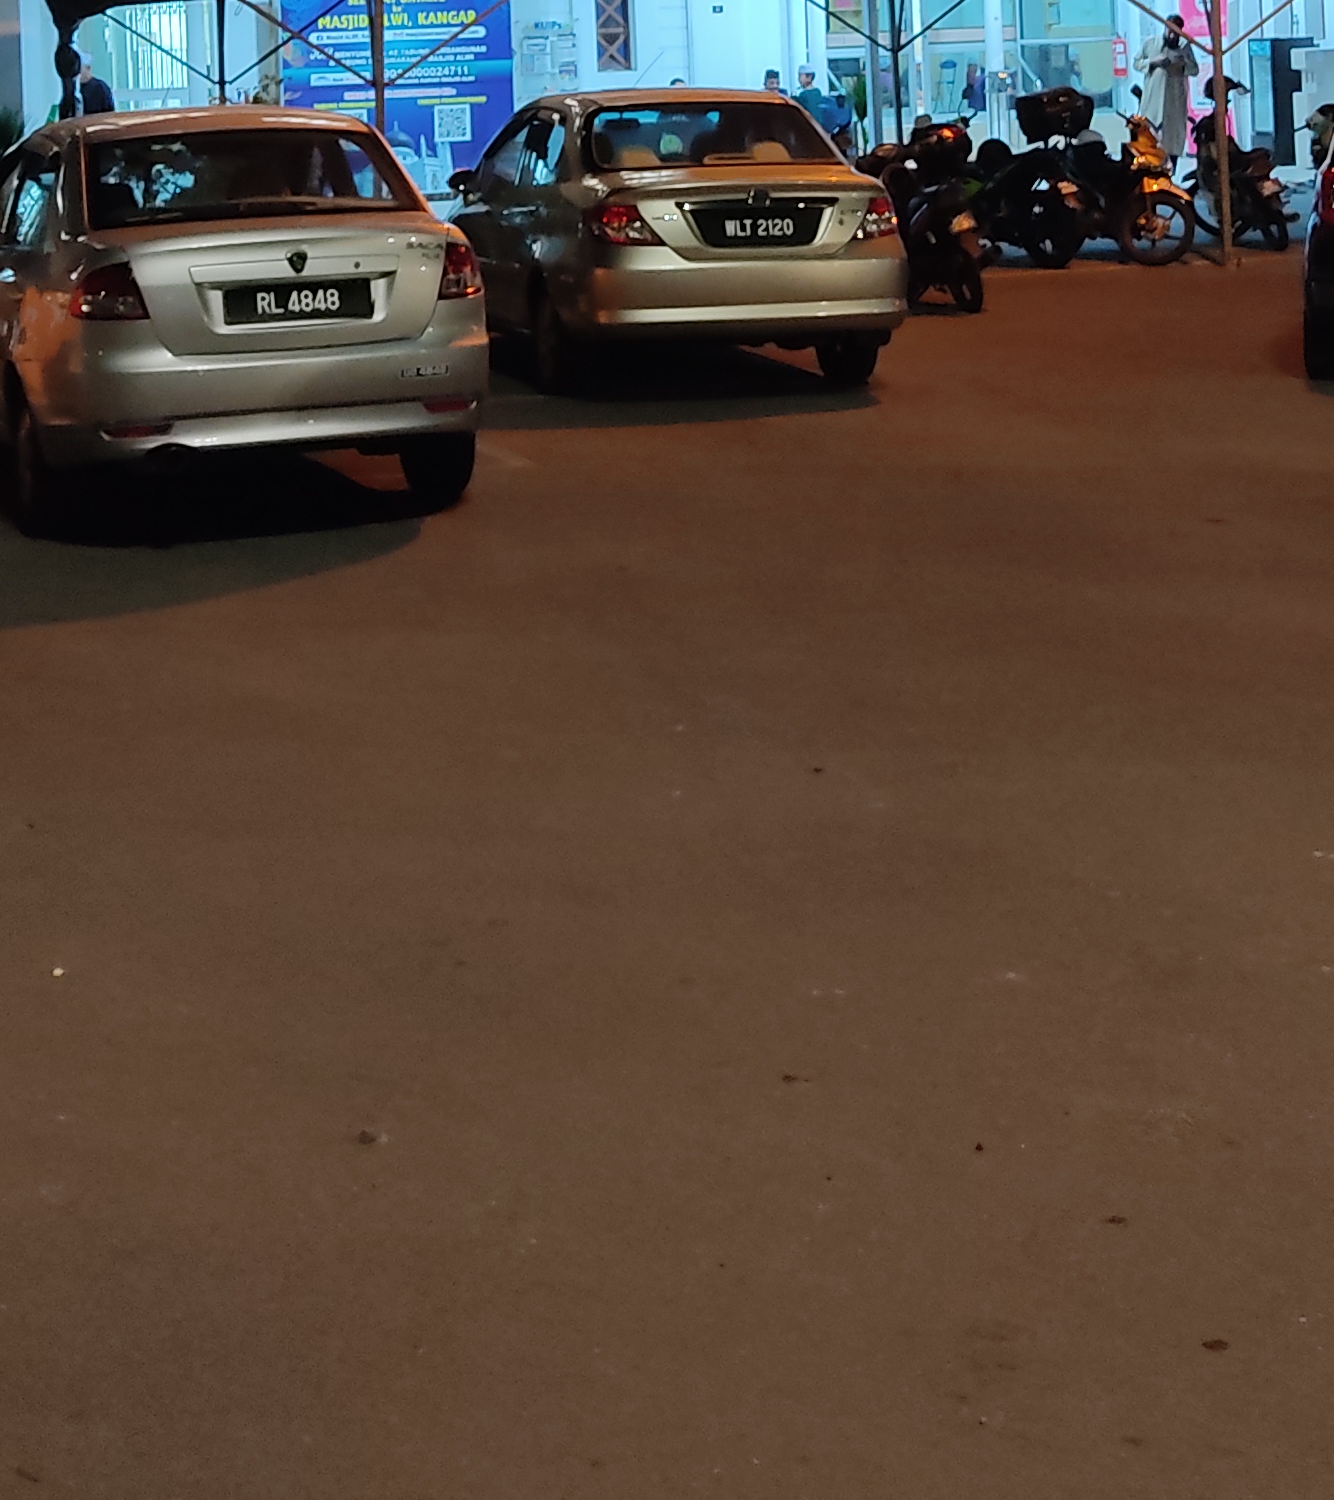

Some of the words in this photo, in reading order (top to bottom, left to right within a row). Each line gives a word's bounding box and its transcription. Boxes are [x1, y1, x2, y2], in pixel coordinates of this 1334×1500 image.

[318, 13, 369, 30] MASJID
[373, 13, 412, 28] LWI,
[724, 218, 753, 237] WLT
[756, 218, 794, 236] 2120
[256, 291, 285, 315] RL
[287, 288, 340, 313] 4848
